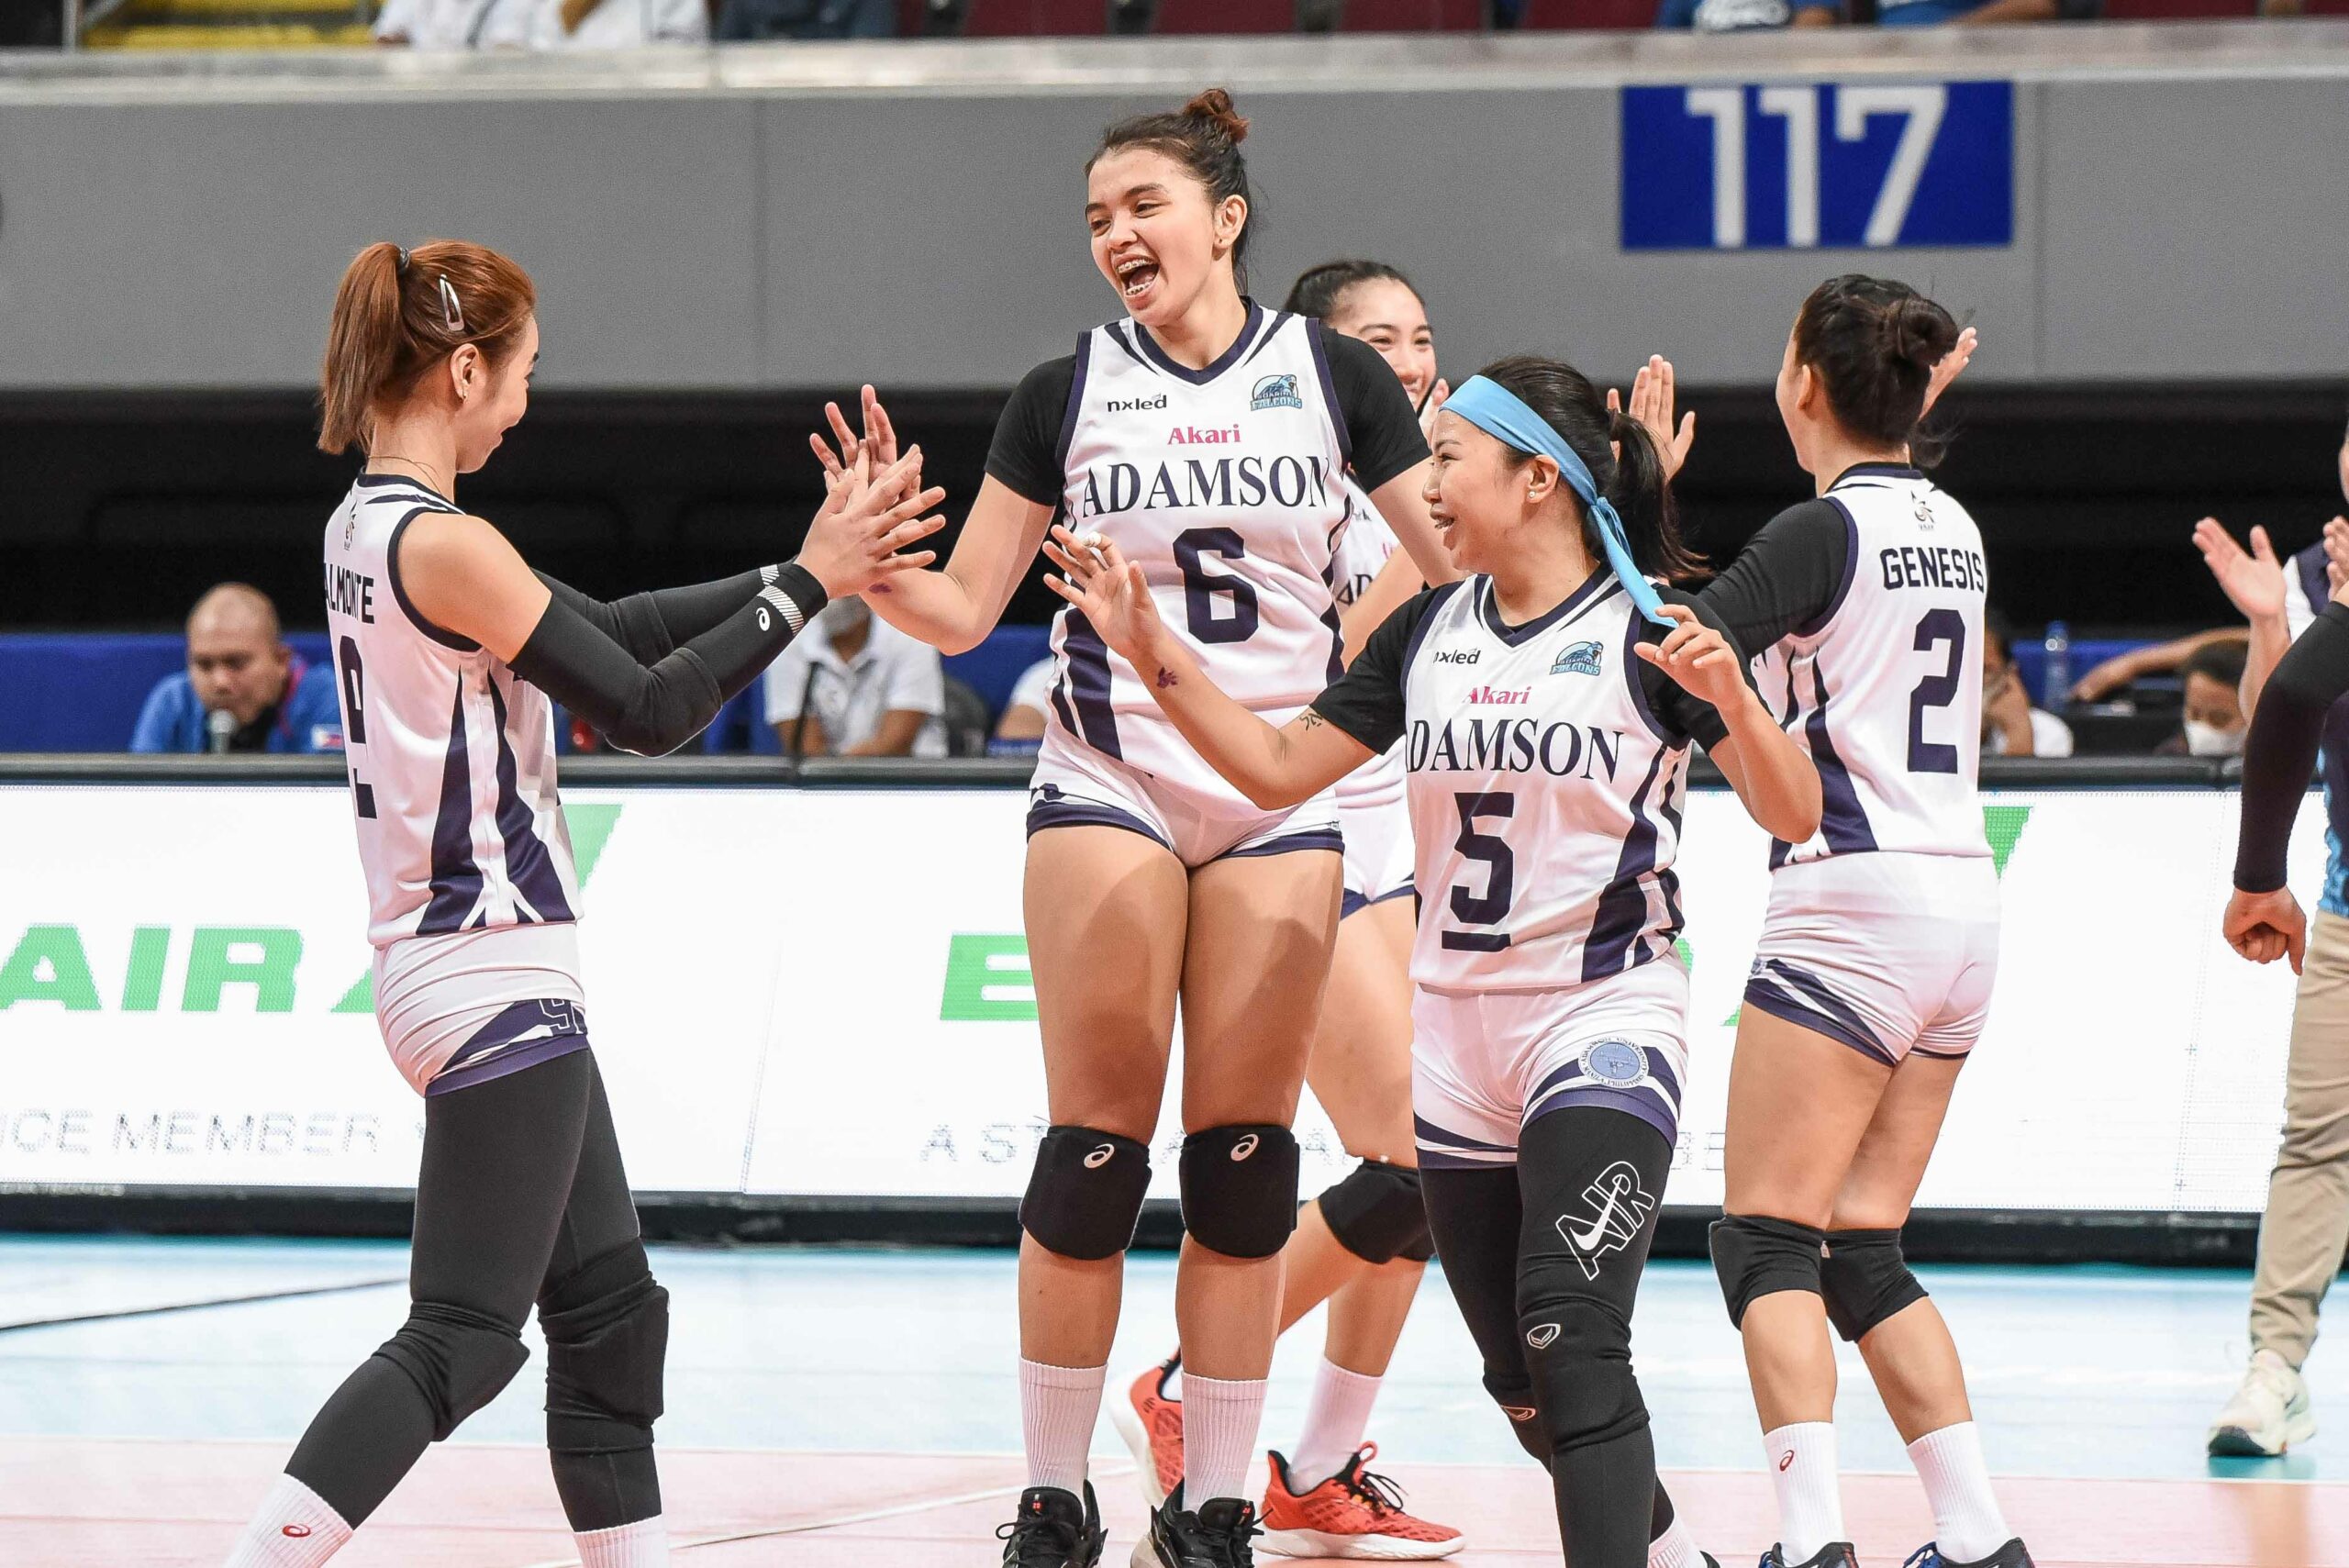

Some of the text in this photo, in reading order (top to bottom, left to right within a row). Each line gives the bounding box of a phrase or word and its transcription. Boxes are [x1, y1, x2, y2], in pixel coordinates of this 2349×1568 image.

[1686, 86, 1948, 247] 117
[1107, 394, 1167, 412] nxled
[1167, 424, 1241, 445] Akari
[1082, 455, 1330, 518] ADAMSON
[1173, 527, 1259, 644] 6
[1879, 547, 1985, 594] GENESIS
[1462, 686, 1531, 705] Akari
[1907, 608, 1966, 774] 2
[1406, 718, 1625, 784] DAMSON
[1450, 792, 1514, 926] 5
[0, 926, 305, 1013] AIR
[111, 1111, 382, 1157] MEMBER
